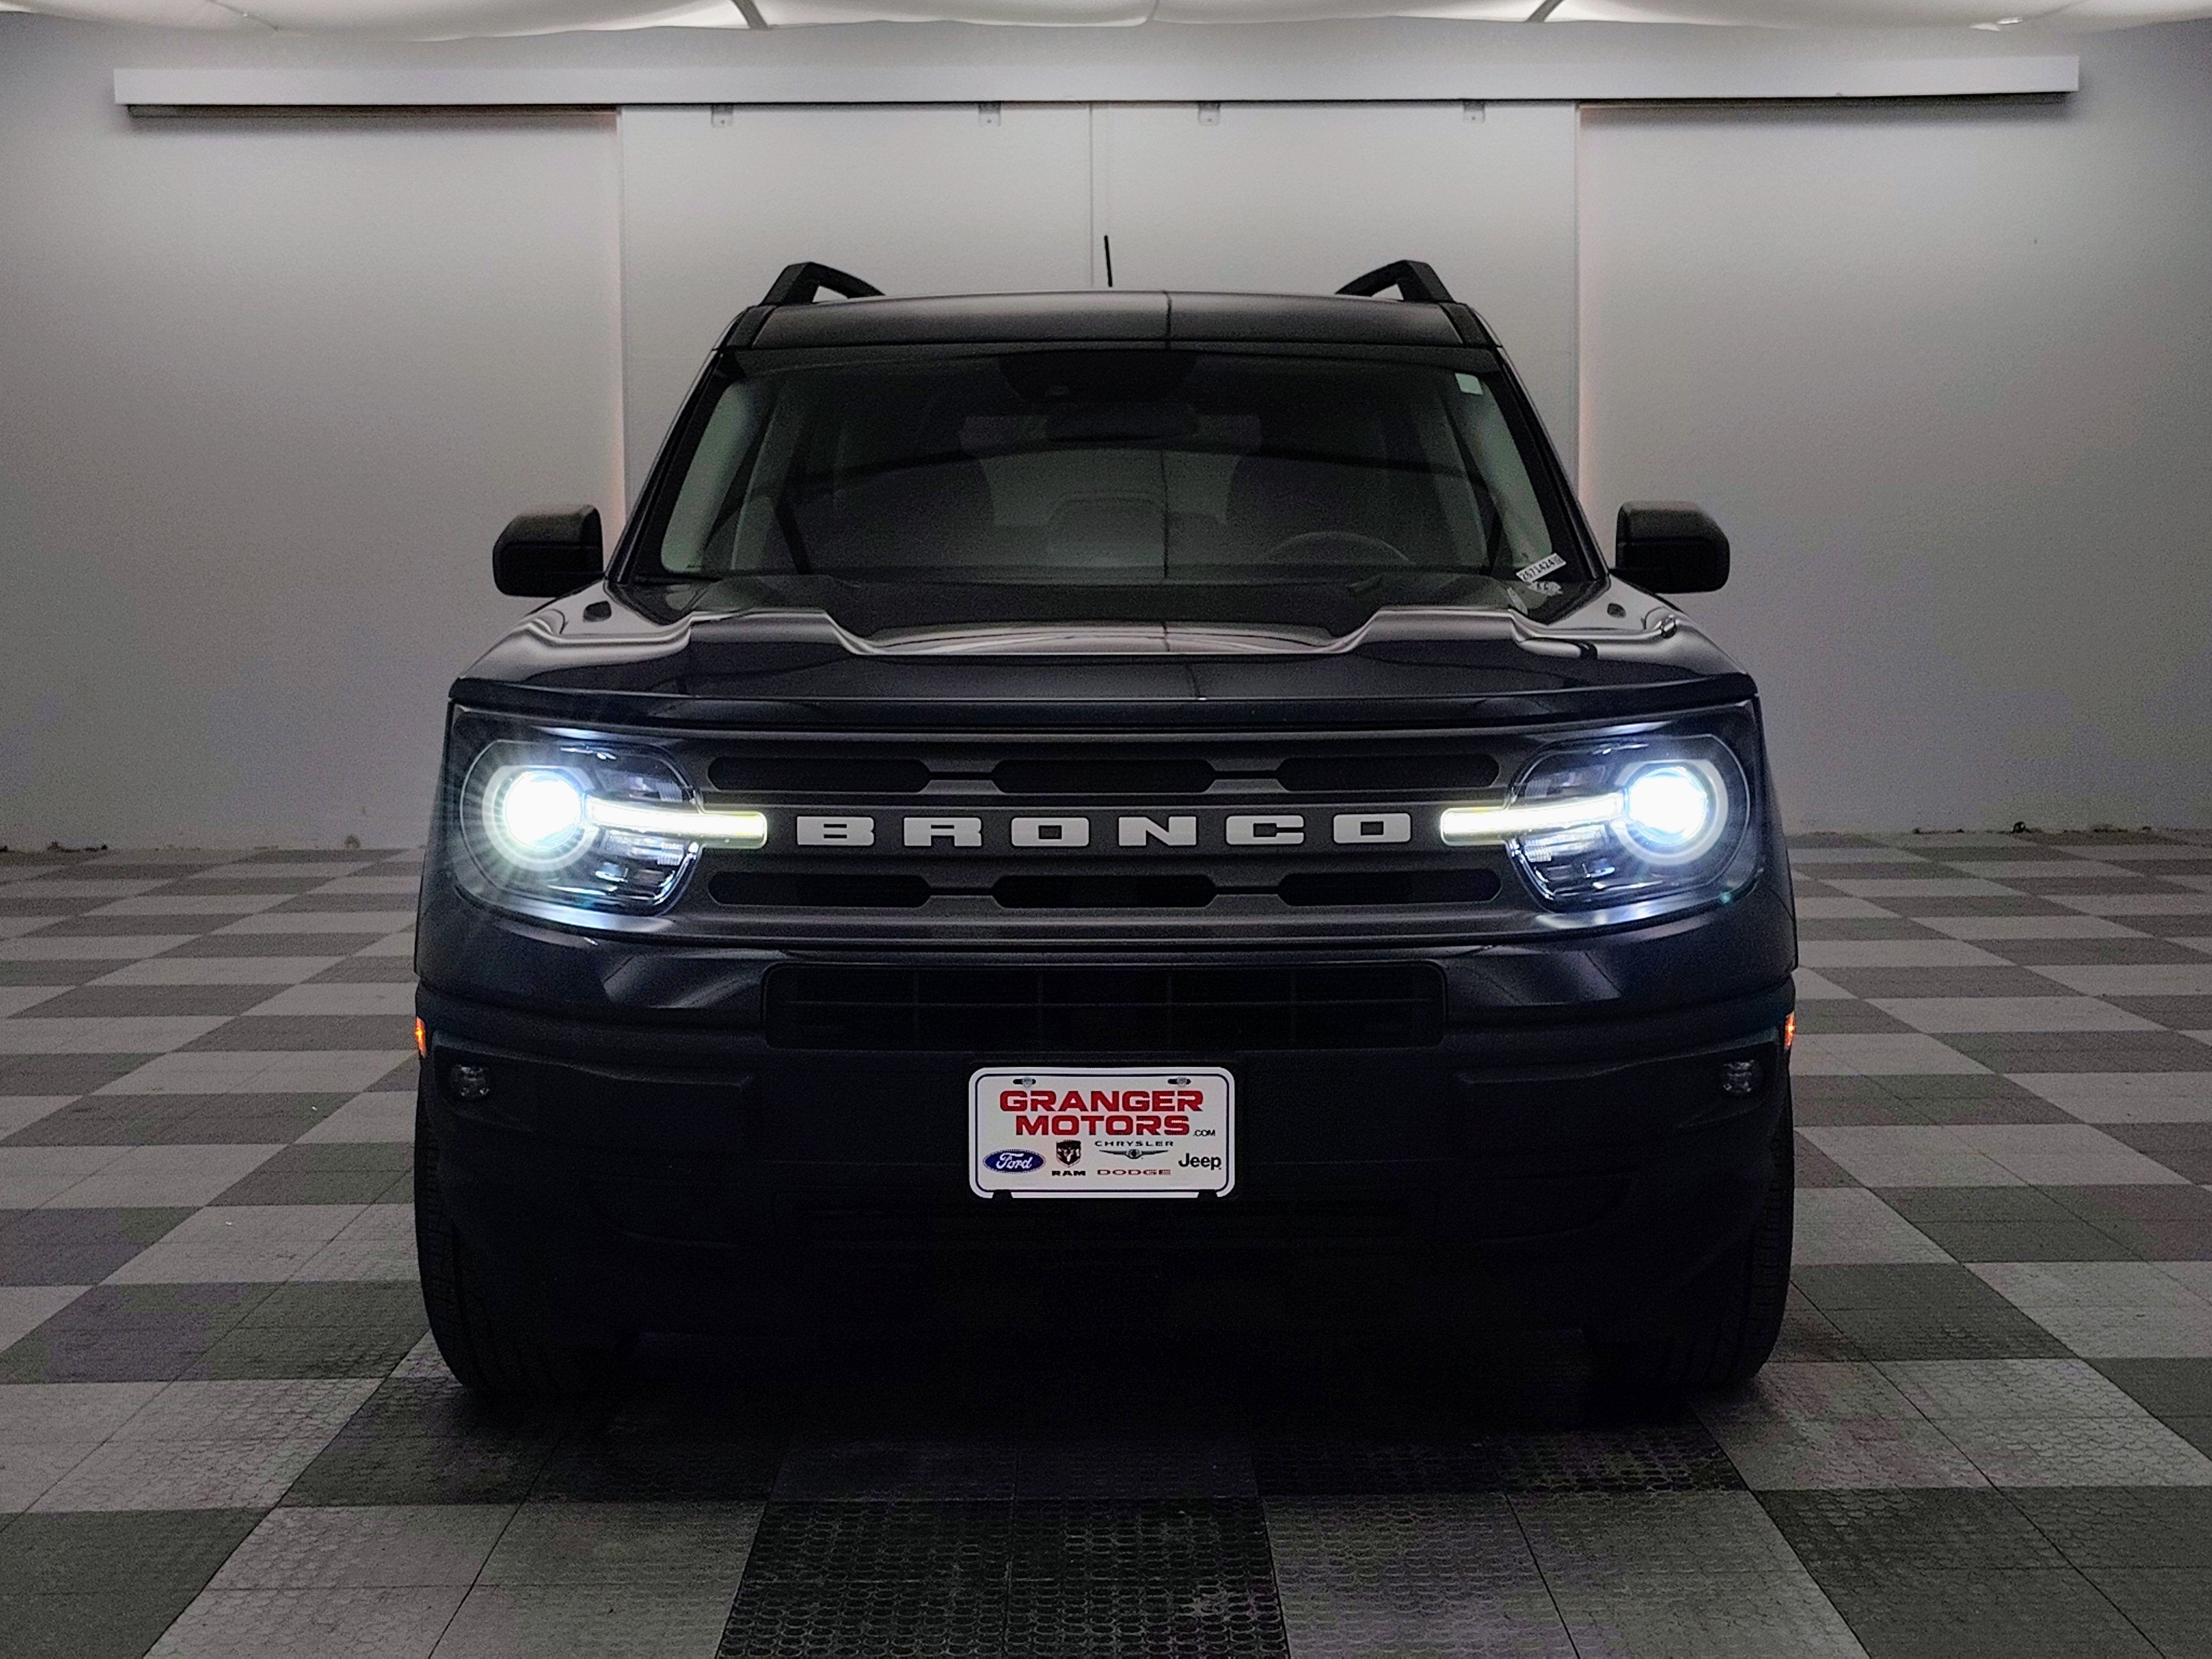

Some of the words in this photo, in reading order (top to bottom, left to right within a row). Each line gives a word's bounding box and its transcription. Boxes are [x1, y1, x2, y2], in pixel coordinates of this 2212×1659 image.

[797, 812, 1412, 847] BRONCO
[1000, 1090, 1204, 1112] GRANGER
[1016, 1115, 1190, 1136] MOTORS
[1193, 1129, 1216, 1137] .COM
[996, 1152, 1034, 1170] Ford
[1178, 1153, 1222, 1171] Jeep
